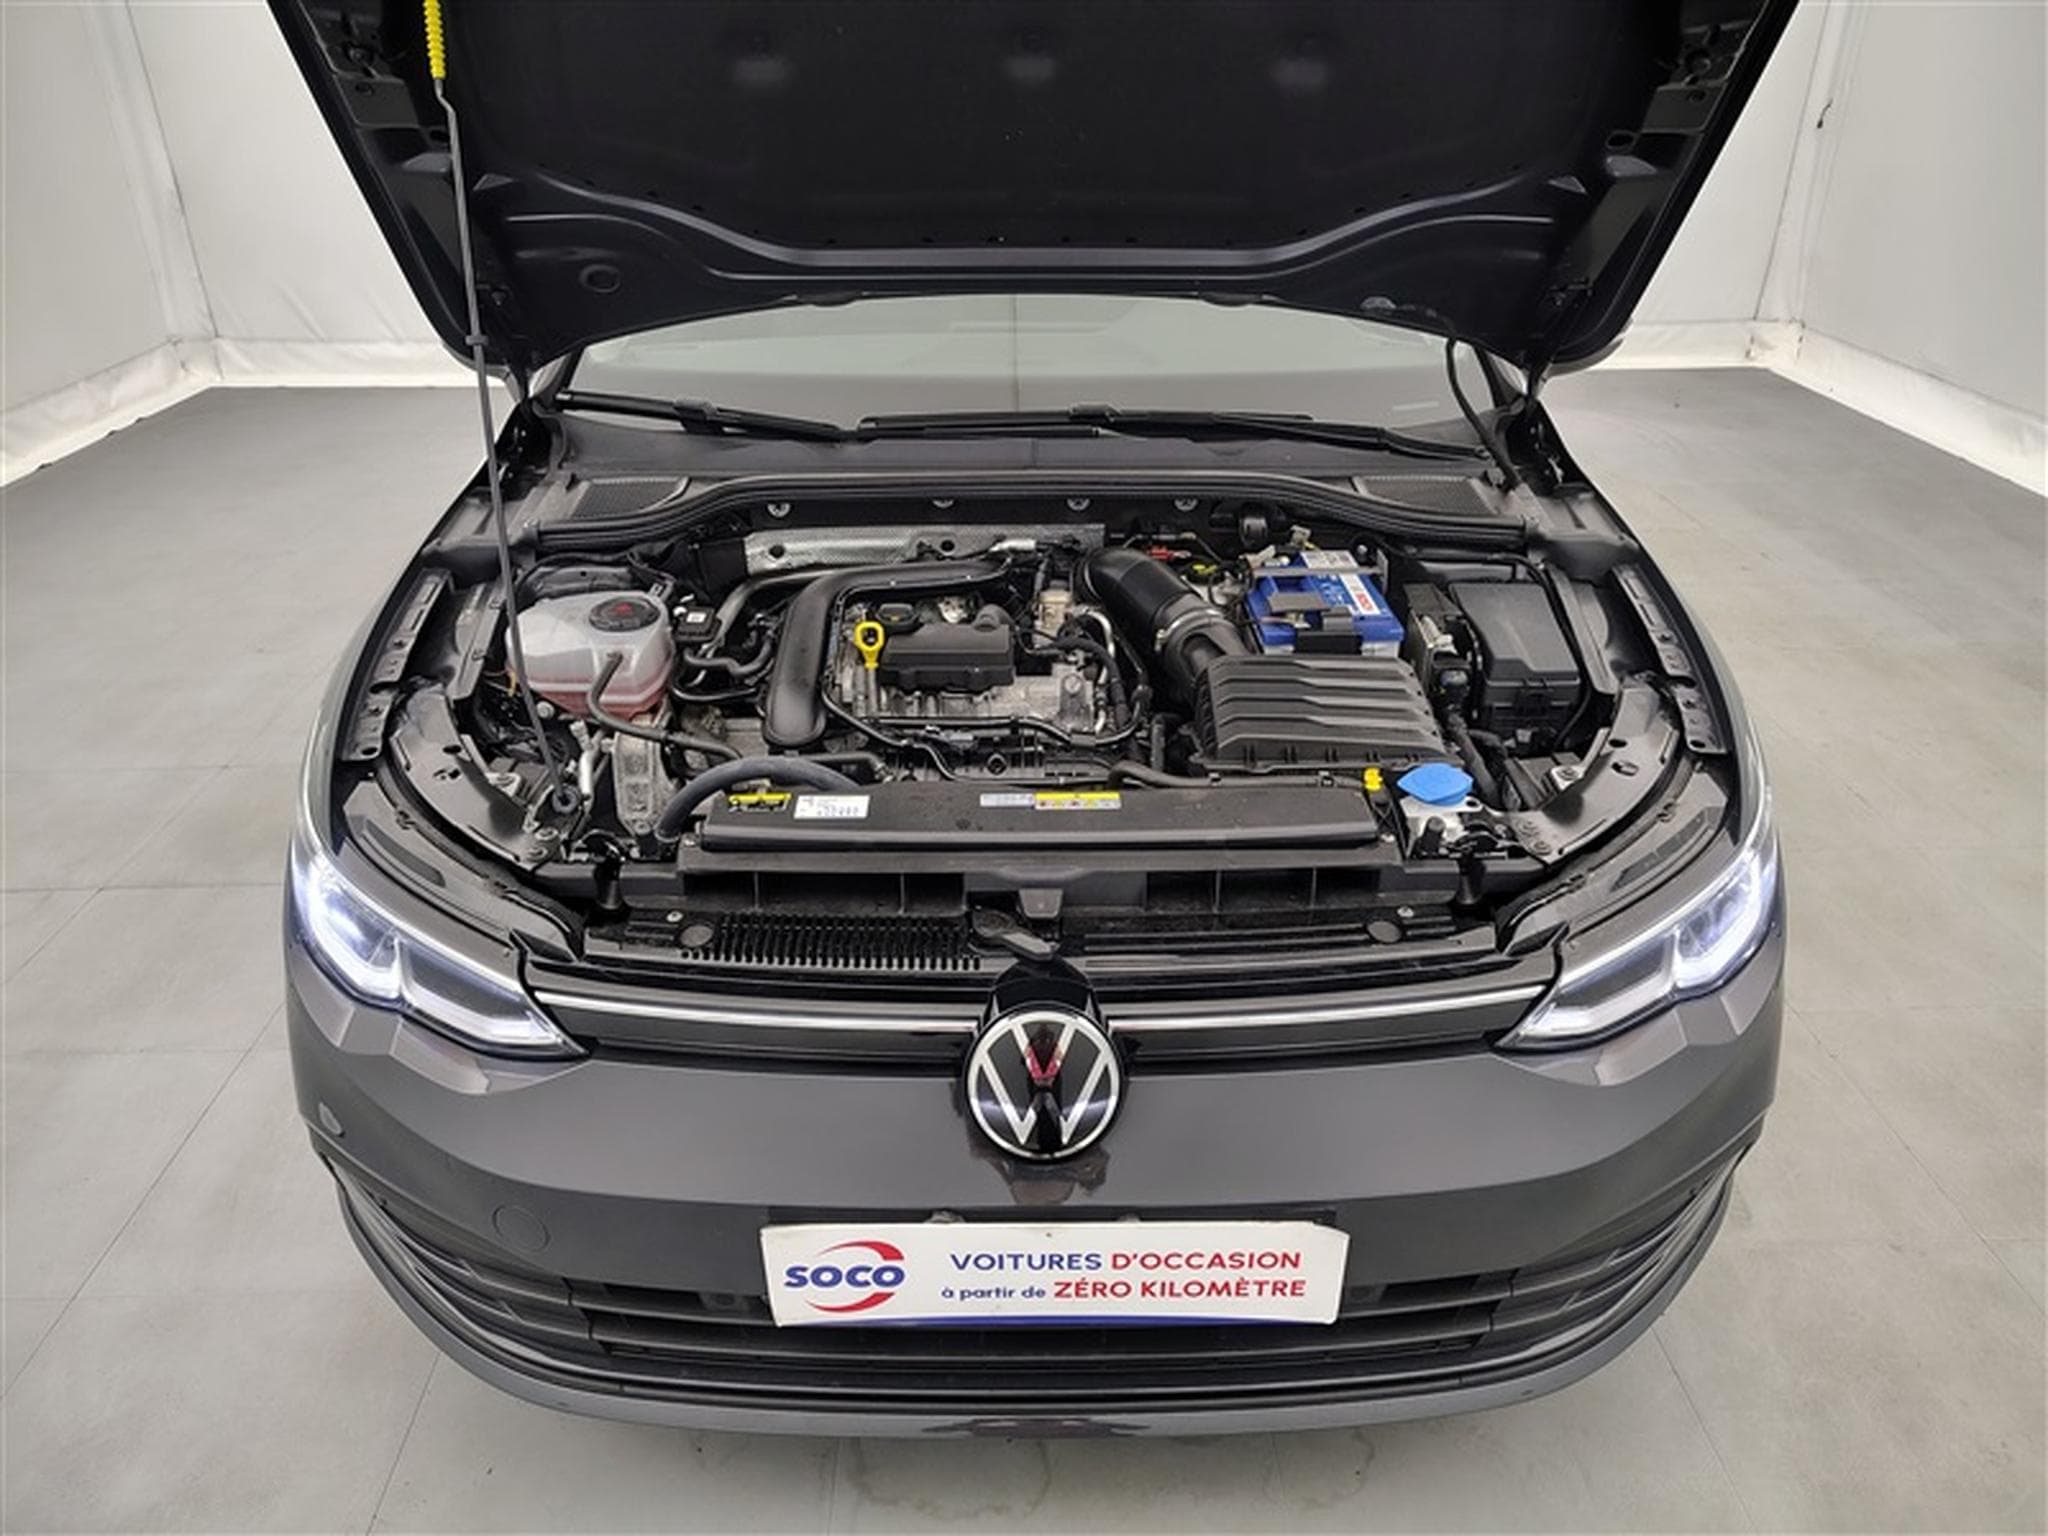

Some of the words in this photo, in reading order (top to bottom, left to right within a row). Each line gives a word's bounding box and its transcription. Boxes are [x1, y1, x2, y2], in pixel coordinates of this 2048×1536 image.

[950, 1252, 1102, 1271] VOITURES
[1110, 1250, 1302, 1271] D'OCCASION
[784, 1264, 905, 1289] SOCO
[941, 1286, 955, 1300] à
[959, 1284, 1016, 1302] partir
[1021, 1285, 1046, 1298] de
[1054, 1277, 1132, 1298] ZÉRO
[1139, 1276, 1306, 1298] KILOMÈTRE
